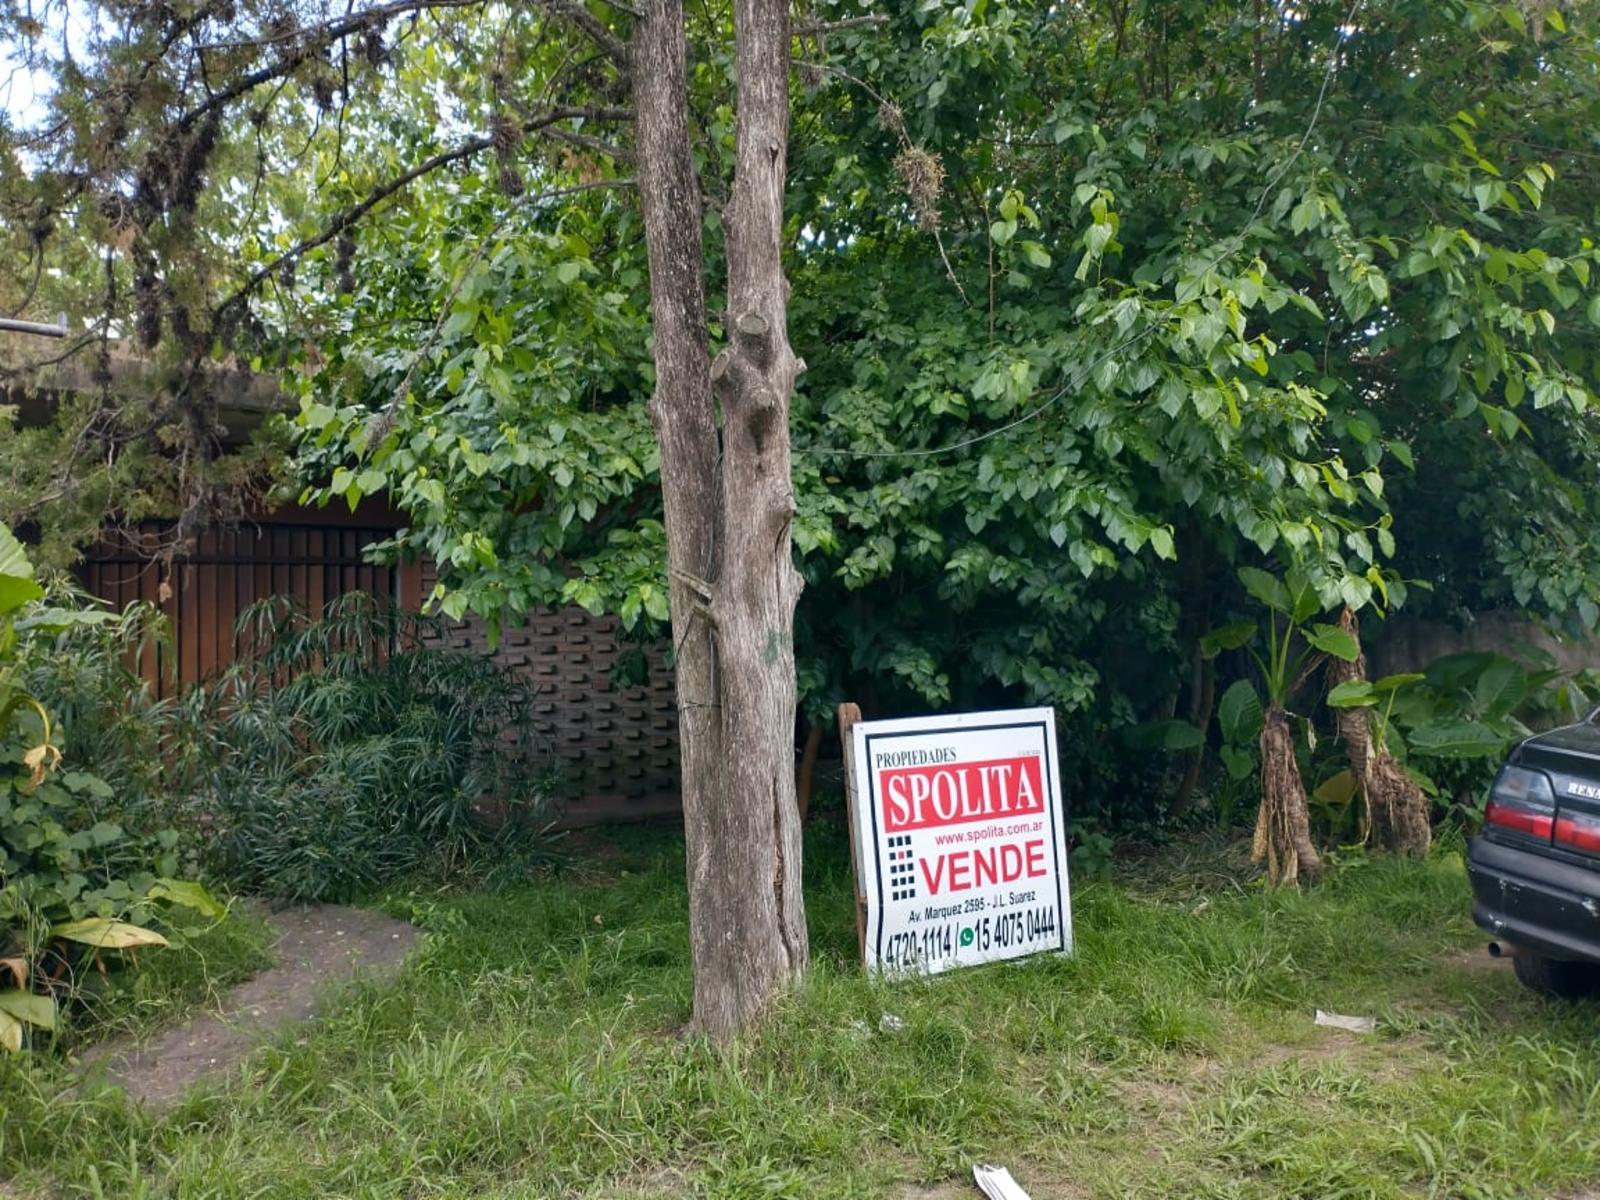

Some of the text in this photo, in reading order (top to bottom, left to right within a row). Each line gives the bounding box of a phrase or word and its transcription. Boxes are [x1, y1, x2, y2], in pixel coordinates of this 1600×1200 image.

[876, 747, 956, 768] PROPIEDADES
[888, 763, 1038, 826] SPOLITA
[934, 821, 1044, 846] www.spolita.com.ar
[919, 839, 1047, 895] VENDE
[908, 909, 922, 923] Av.
[924, 901, 962, 922] Marquez
[964, 898, 985, 914] 2595
[1009, 890, 1036, 905] Suarez
[886, 924, 951, 970] 4720-1114
[974, 918, 990, 952] 15
[994, 911, 1024, 948] 4075
[1027, 905, 1055, 942] 0444
